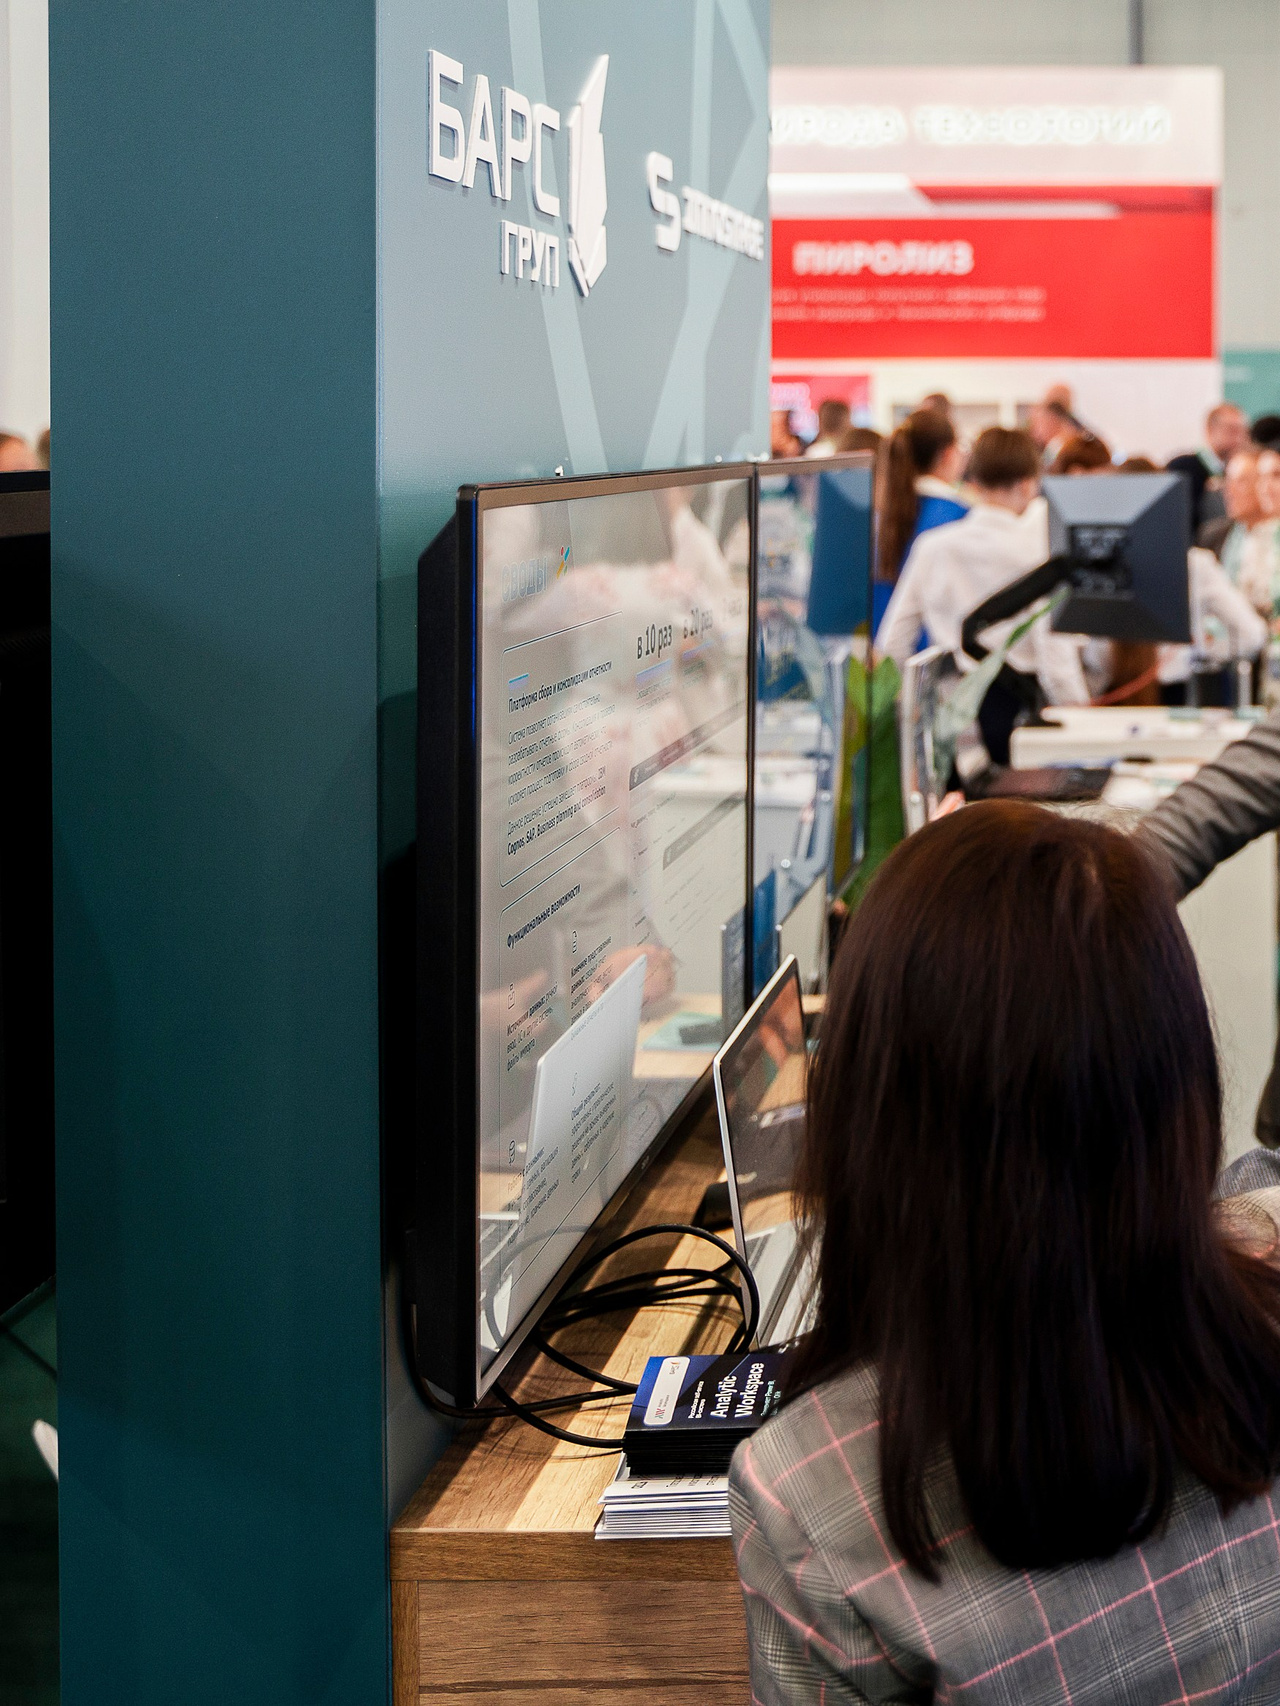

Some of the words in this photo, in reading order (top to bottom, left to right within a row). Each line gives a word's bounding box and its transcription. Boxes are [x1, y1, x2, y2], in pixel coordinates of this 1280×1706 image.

[428, 49, 560, 217] БАРС
[500, 220, 560, 287] ГРУП
[793, 240, 974, 275] ПИРОЛИЗ
[637, 636, 643, 659] в
[645, 623, 656, 656] 10
[657, 624, 672, 658] раз
[508, 691, 538, 713] Платформа
[538, 684, 553, 701] сбора
[556, 670, 589, 693] консолидации
[588, 661, 612, 678] отчетности
[508, 728, 526, 745] Система
[526, 718, 547, 737] позволяет
[507, 763, 537, 786] корректности
[536, 753, 552, 771] отчетов
[508, 743, 539, 766] разрабатывать
[508, 787, 527, 807] ускоряет
[526, 778, 544, 797] процесс
[543, 767, 565, 786] подготовки
[507, 818, 523, 838] Данное
[523, 806, 542, 827] решение
[541, 796, 558, 817] успешно
[537, 817, 556, 837] Business
[556, 806, 574, 827] planning
[573, 797, 581, 814] and
[581, 785, 606, 808] consolidation
[507, 906, 551, 950] Функциональные
[550, 883, 580, 914] возможности
[507, 1010, 529, 1036] Источники
[710, 1375, 738, 1418] Analytic
[734, 1362, 765, 1418] Workspace
